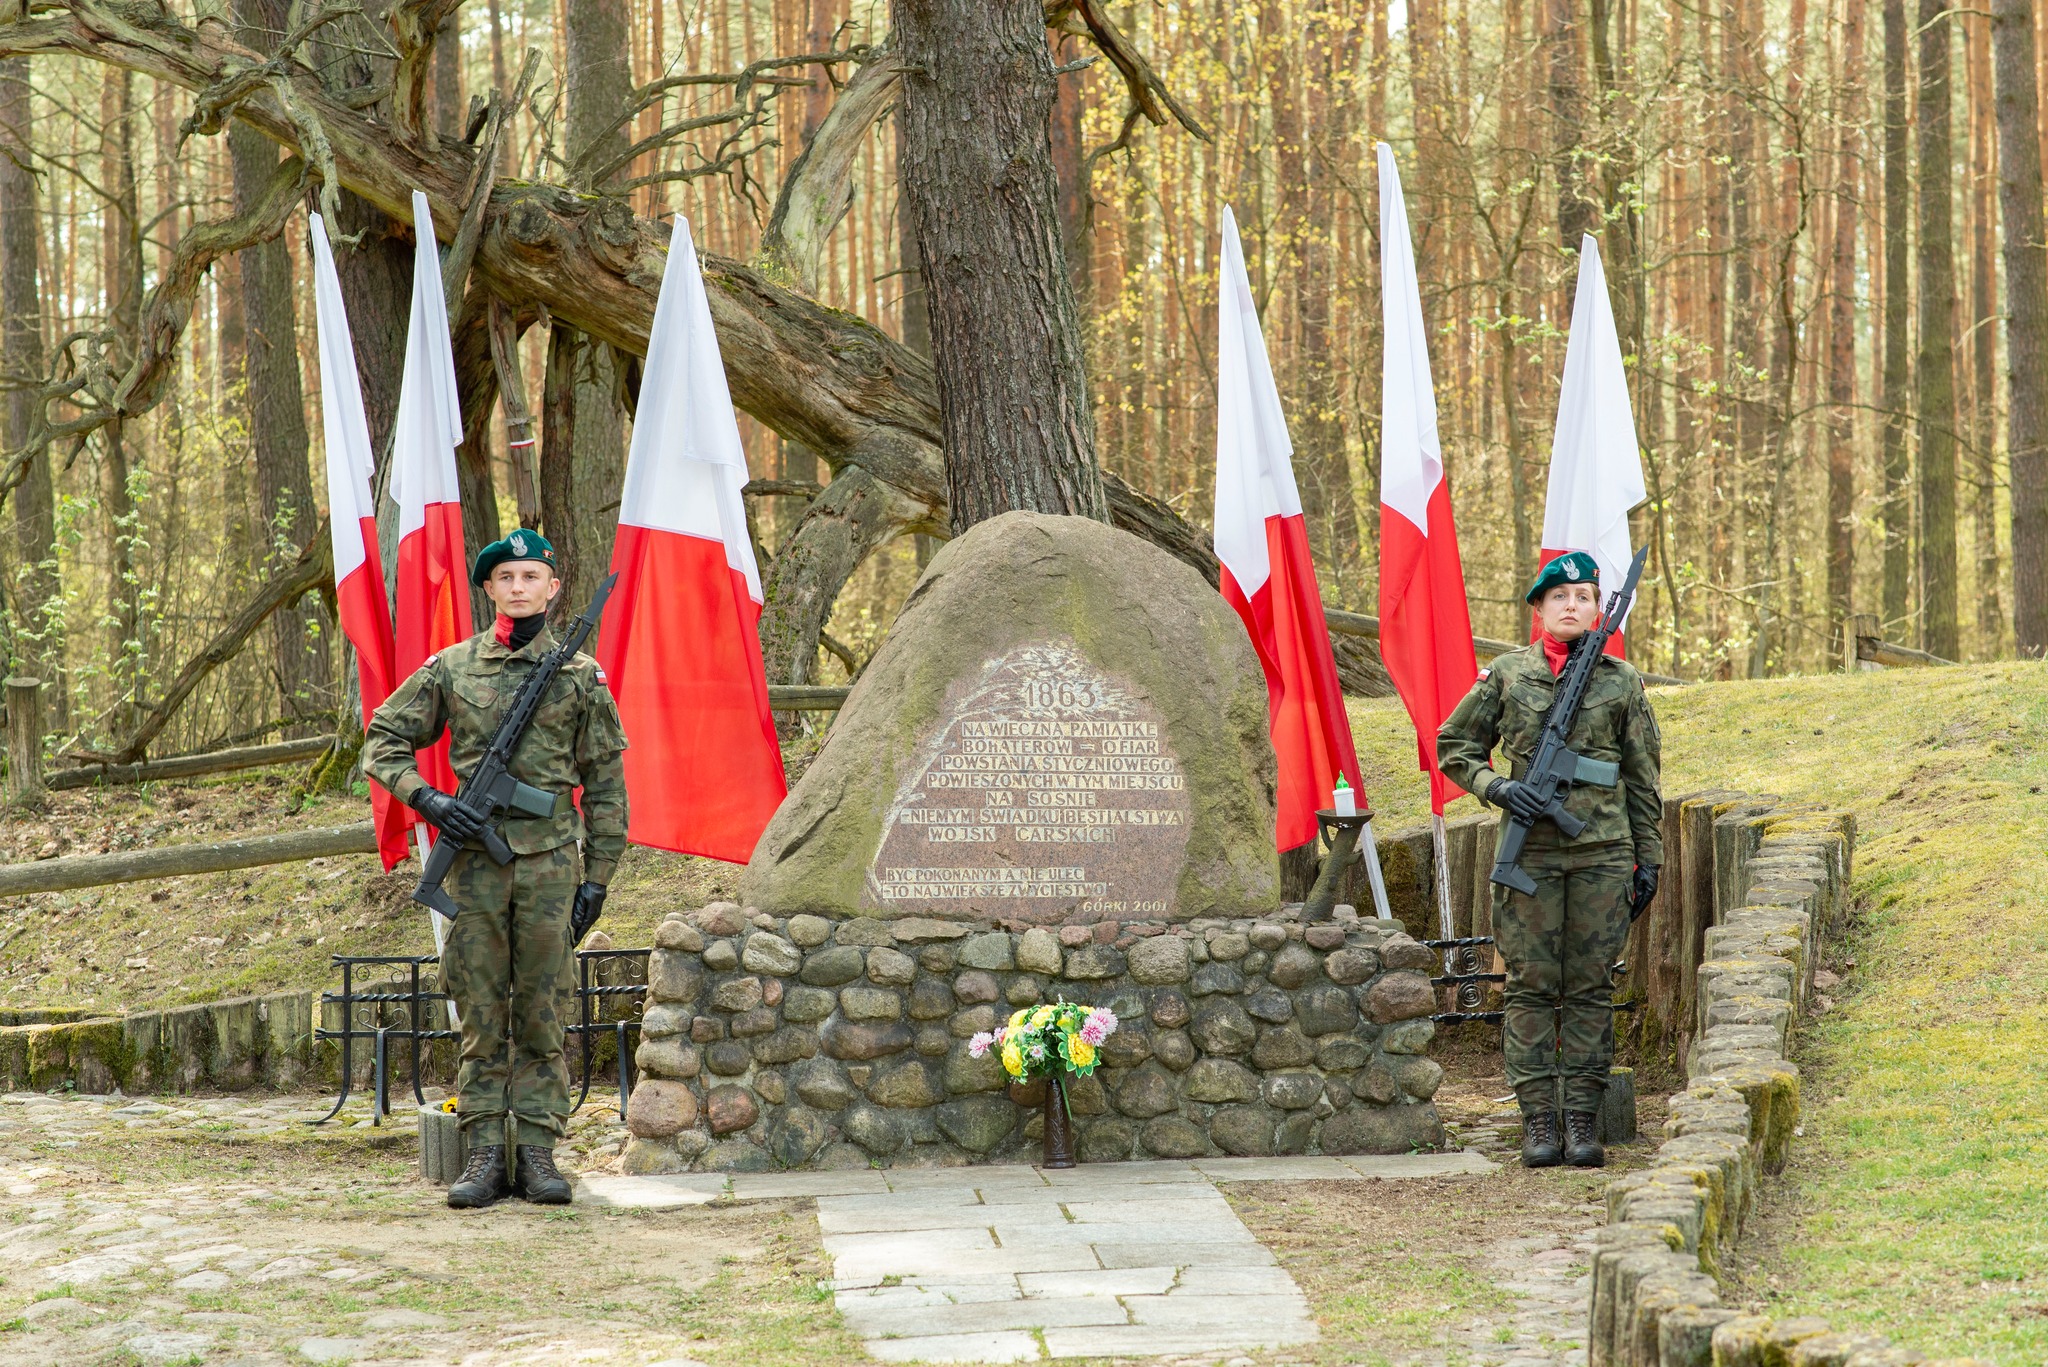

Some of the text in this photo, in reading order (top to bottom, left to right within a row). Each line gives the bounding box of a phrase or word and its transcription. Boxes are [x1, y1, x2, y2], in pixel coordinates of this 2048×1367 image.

[1025, 682, 1097, 708] 1863
[963, 722, 986, 736] NA
[1103, 739, 1157, 753] OFIAR
[942, 756, 1173, 772] POWSTANIA STYCZNIOWEGO
[928, 773, 1182, 790] POWIESZONYCH W TYM MIEJSCU
[986, 792, 1012, 805] NA
[1065, 810, 1183, 825] BESTIALSTWA
[929, 827, 1115, 842] WOJSK CARSKICH
[915, 868, 1000, 881] POKONANYM
[1004, 868, 1016, 880] A
[1019, 867, 1044, 880] NIE
[1048, 867, 1083, 880] ULEC
[1083, 898, 1167, 912] GÓRKI 2001
